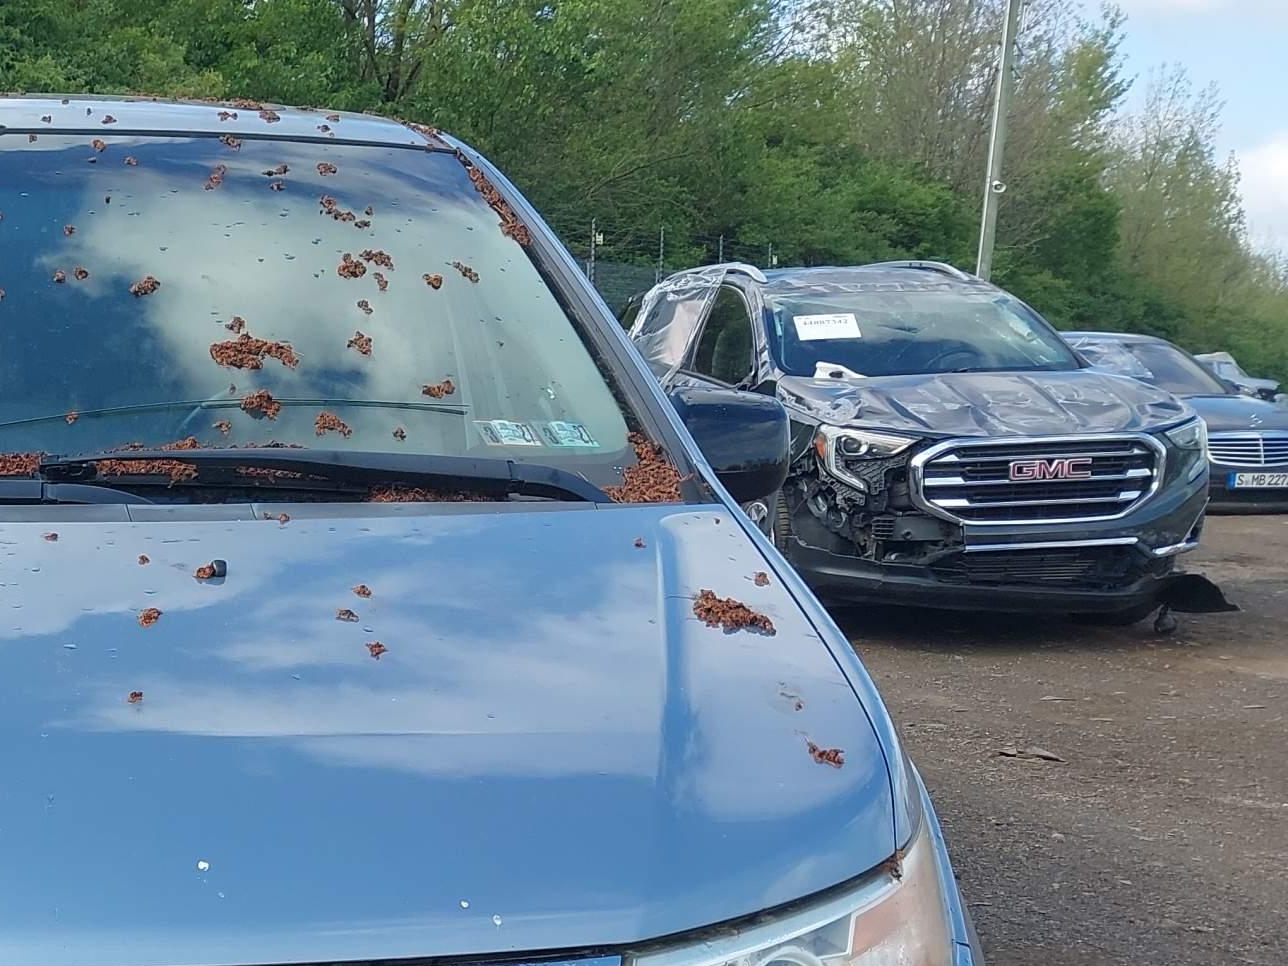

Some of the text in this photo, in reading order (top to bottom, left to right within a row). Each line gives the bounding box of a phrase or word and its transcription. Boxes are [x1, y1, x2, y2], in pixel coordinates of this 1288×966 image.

[1009, 458, 1092, 480] GMC
[1237, 474, 1288, 486] S MB 227
